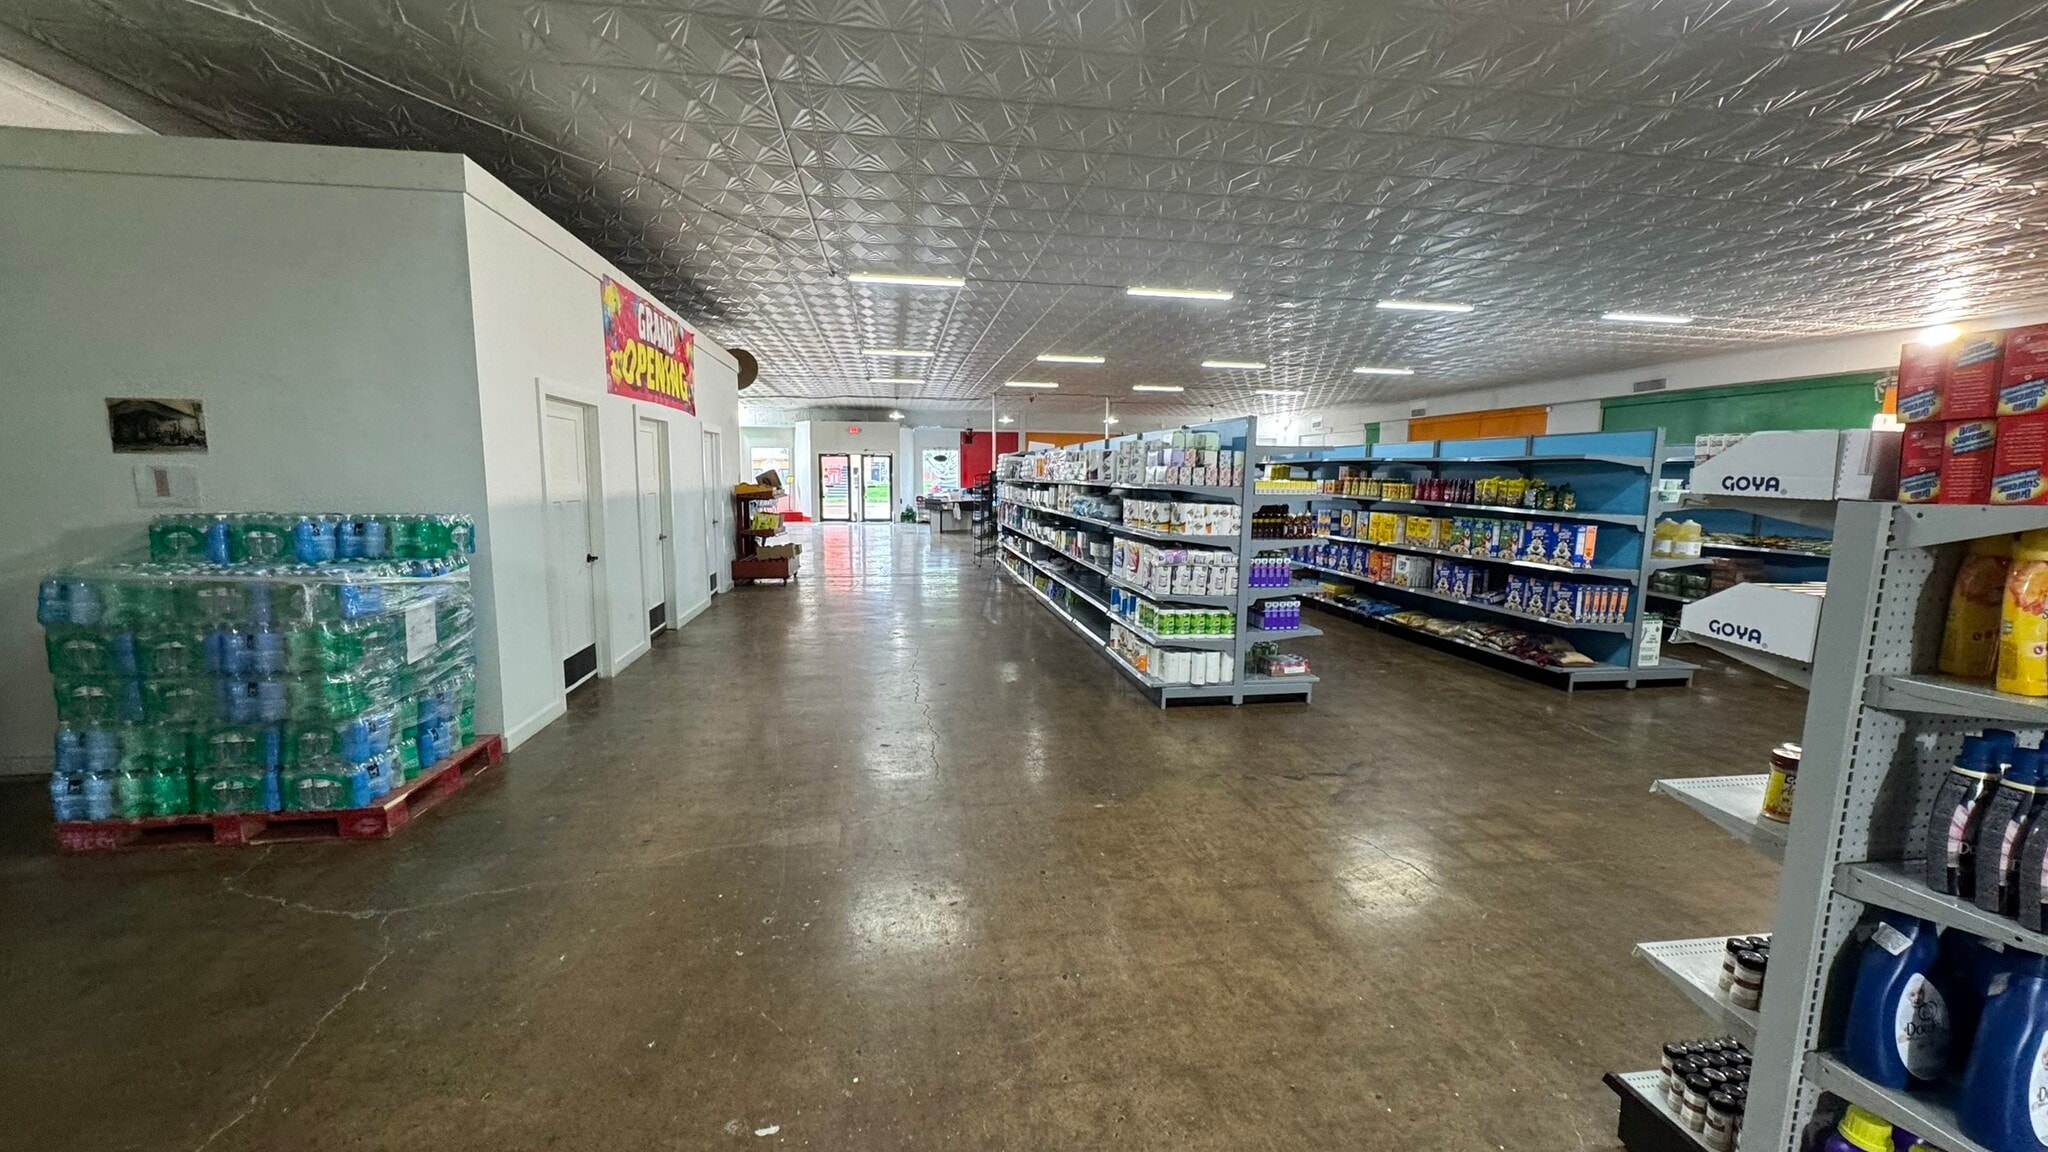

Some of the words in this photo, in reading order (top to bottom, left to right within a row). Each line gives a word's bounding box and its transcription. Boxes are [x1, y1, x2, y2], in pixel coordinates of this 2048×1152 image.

[638, 302, 675, 355] GRAND
[622, 338, 689, 401] OPENING
[1722, 476, 1780, 492] GOYA
[1709, 619, 1762, 645] GOYA
